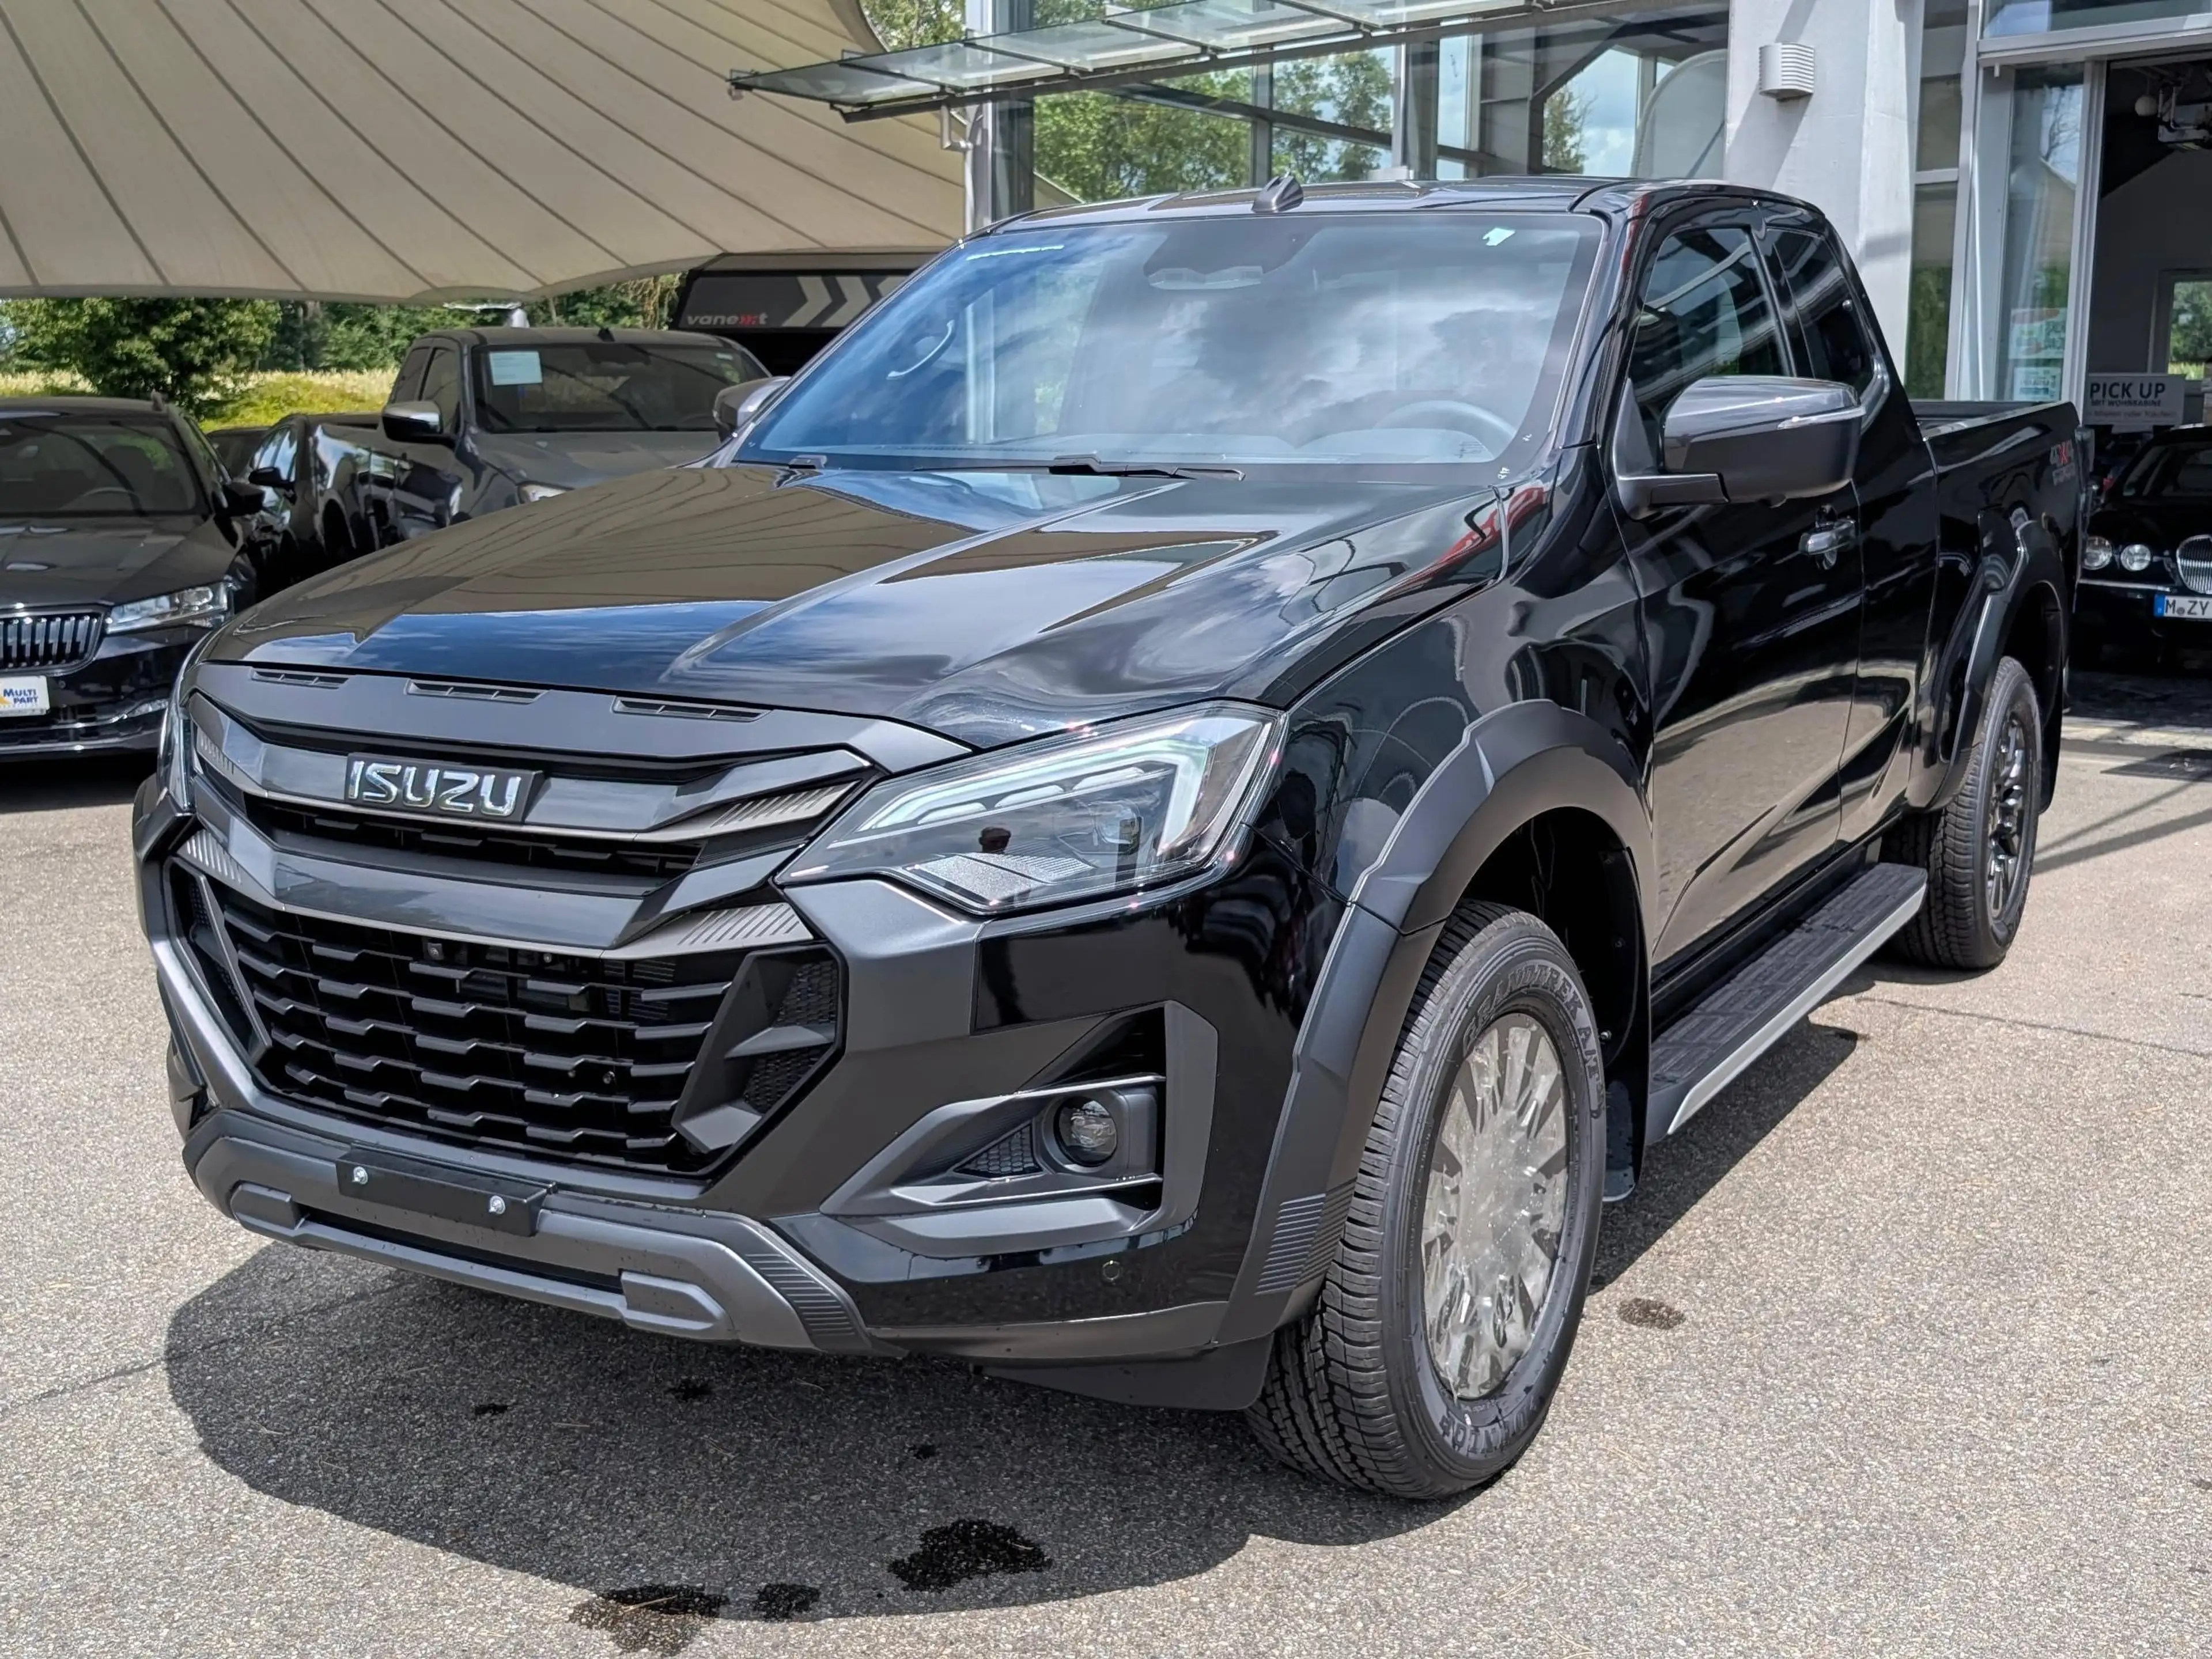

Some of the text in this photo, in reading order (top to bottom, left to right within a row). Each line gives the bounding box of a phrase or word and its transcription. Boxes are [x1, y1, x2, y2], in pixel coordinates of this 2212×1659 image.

[2090, 382, 2166, 399] PICK UP
[3, 688, 37, 698] MULTI
[13, 696, 39, 704] PART
[347, 760, 521, 817] ISUZU
